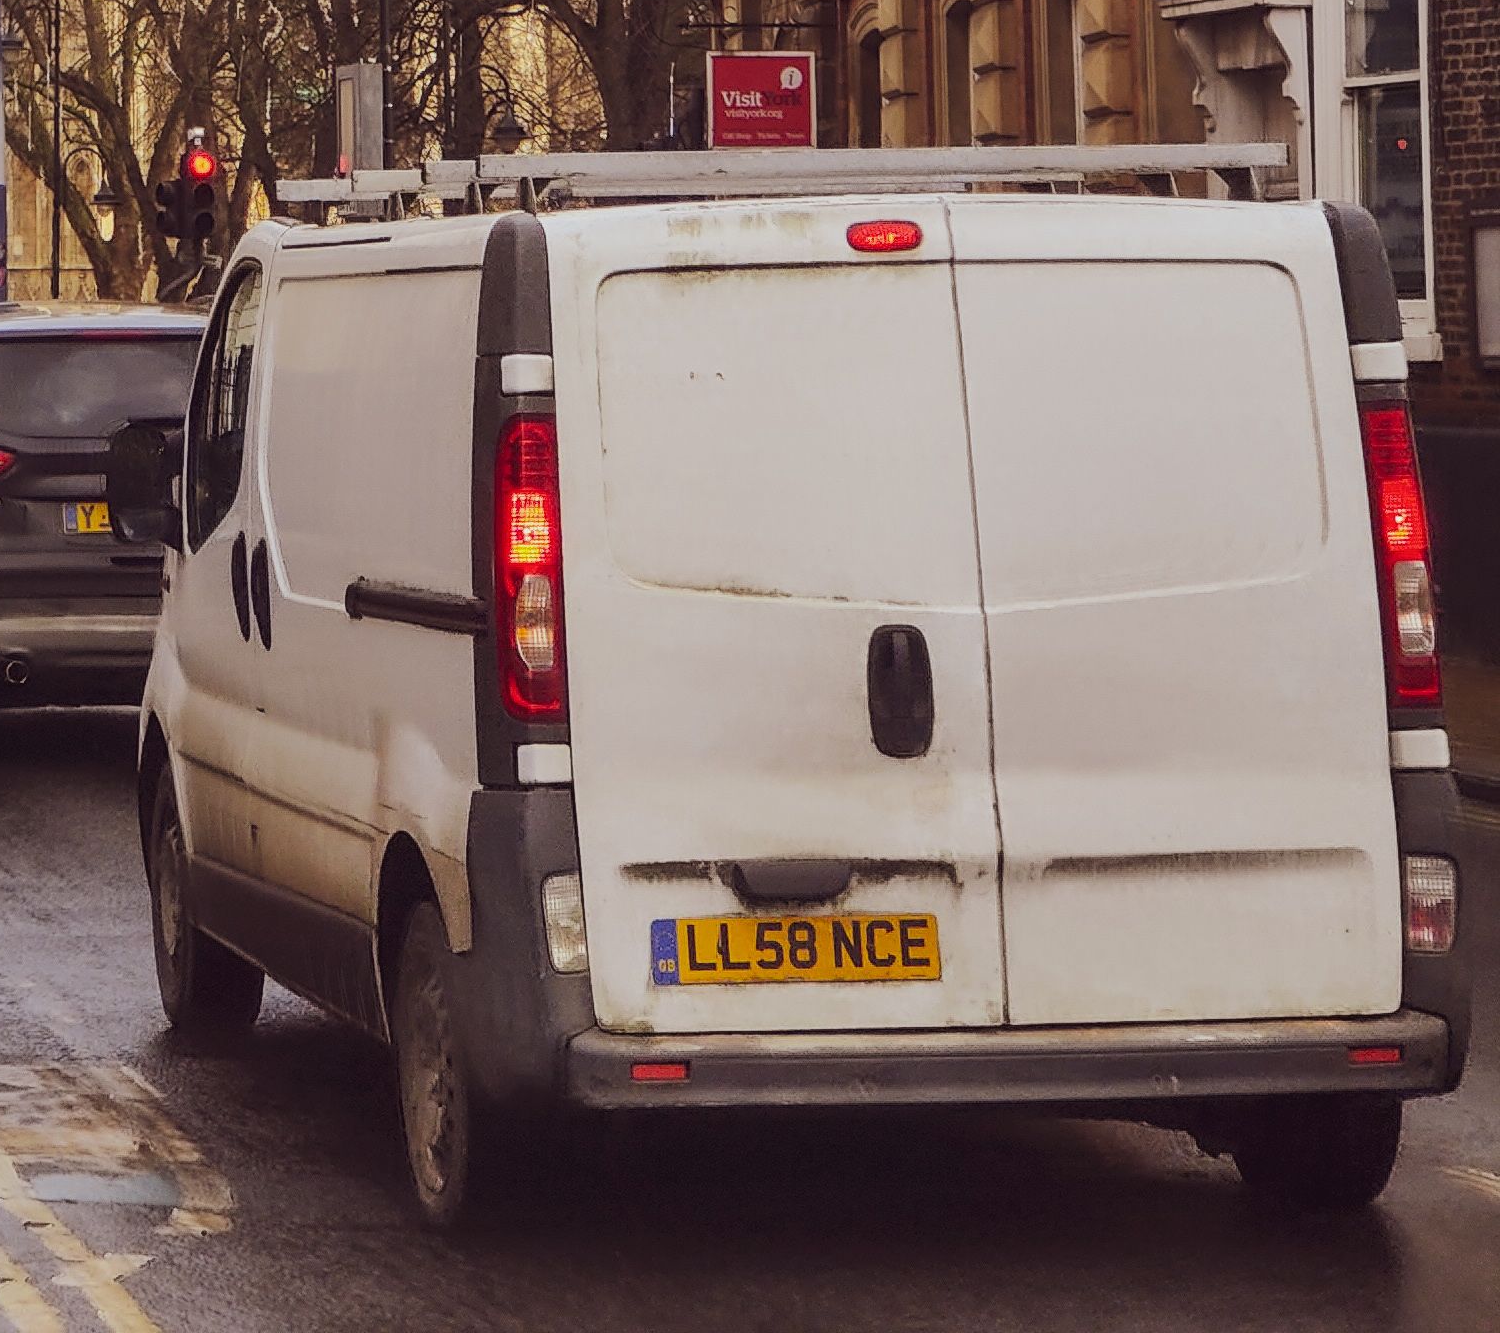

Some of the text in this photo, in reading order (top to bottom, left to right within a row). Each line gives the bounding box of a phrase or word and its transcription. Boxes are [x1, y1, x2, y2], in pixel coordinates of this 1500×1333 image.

[721, 90, 763, 107] Visit
[686, 918, 931, 972] LL58 NCE
